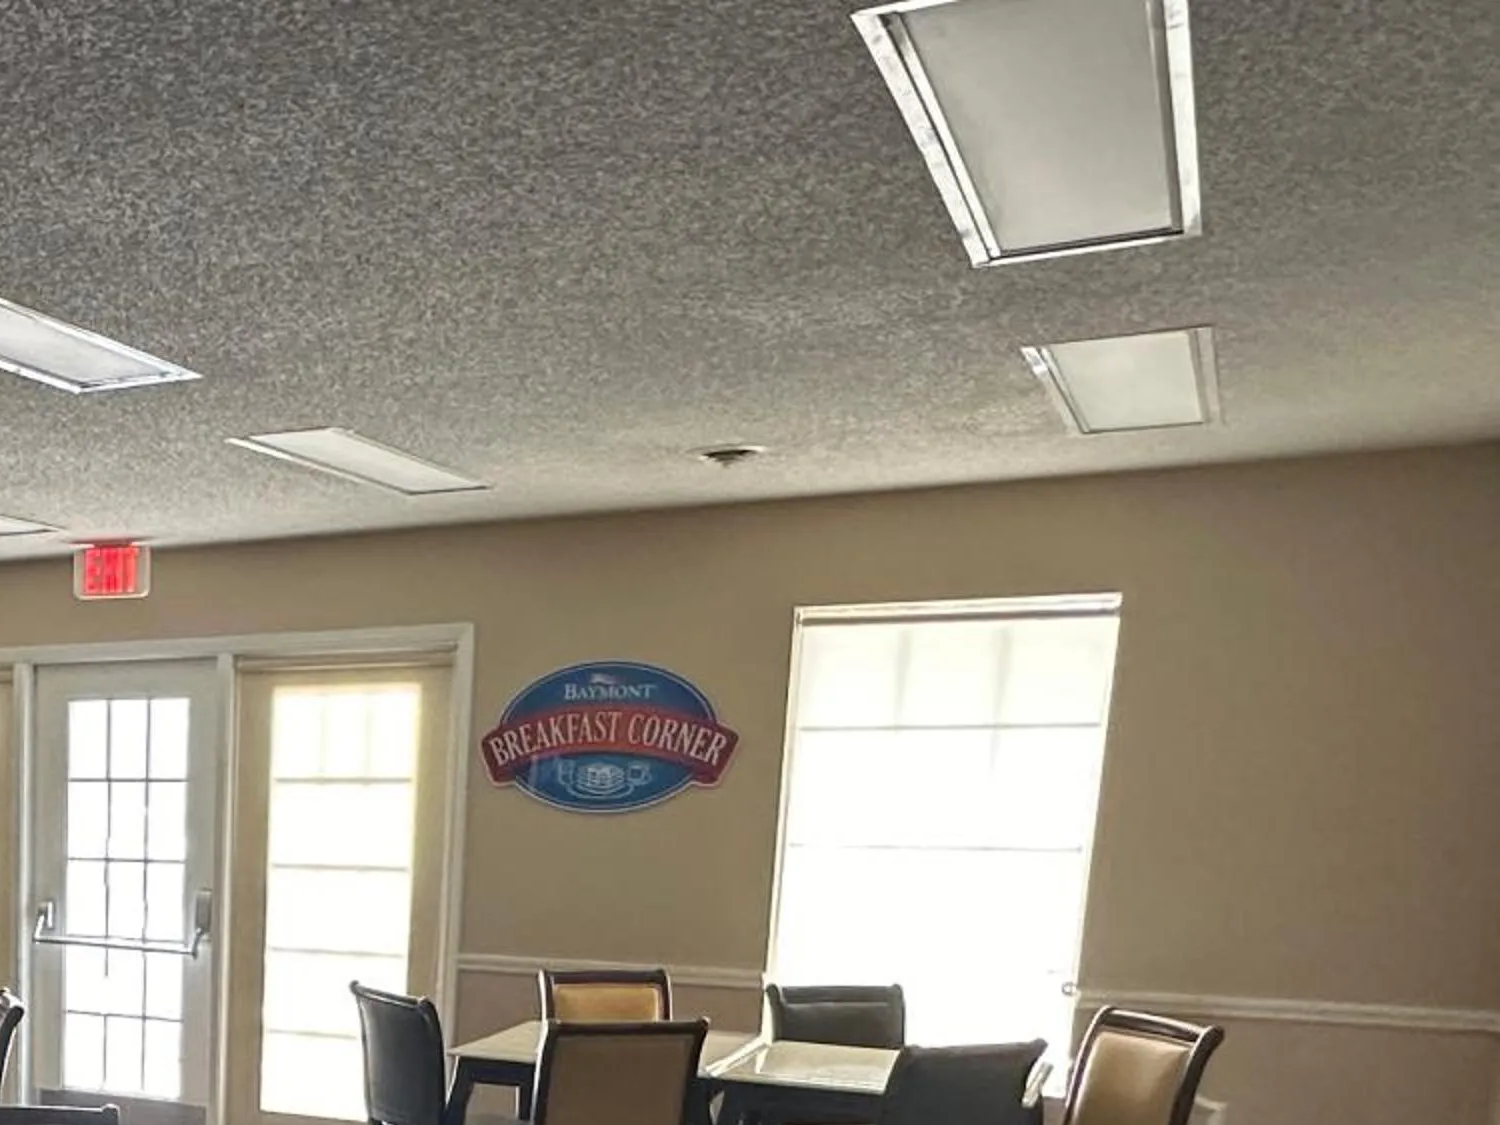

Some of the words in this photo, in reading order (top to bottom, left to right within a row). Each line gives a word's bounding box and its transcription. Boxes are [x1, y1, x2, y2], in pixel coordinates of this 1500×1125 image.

[84, 547, 139, 594] EXIT
[488, 711, 623, 767] BREAKFAST
[627, 714, 728, 767] CORNER
